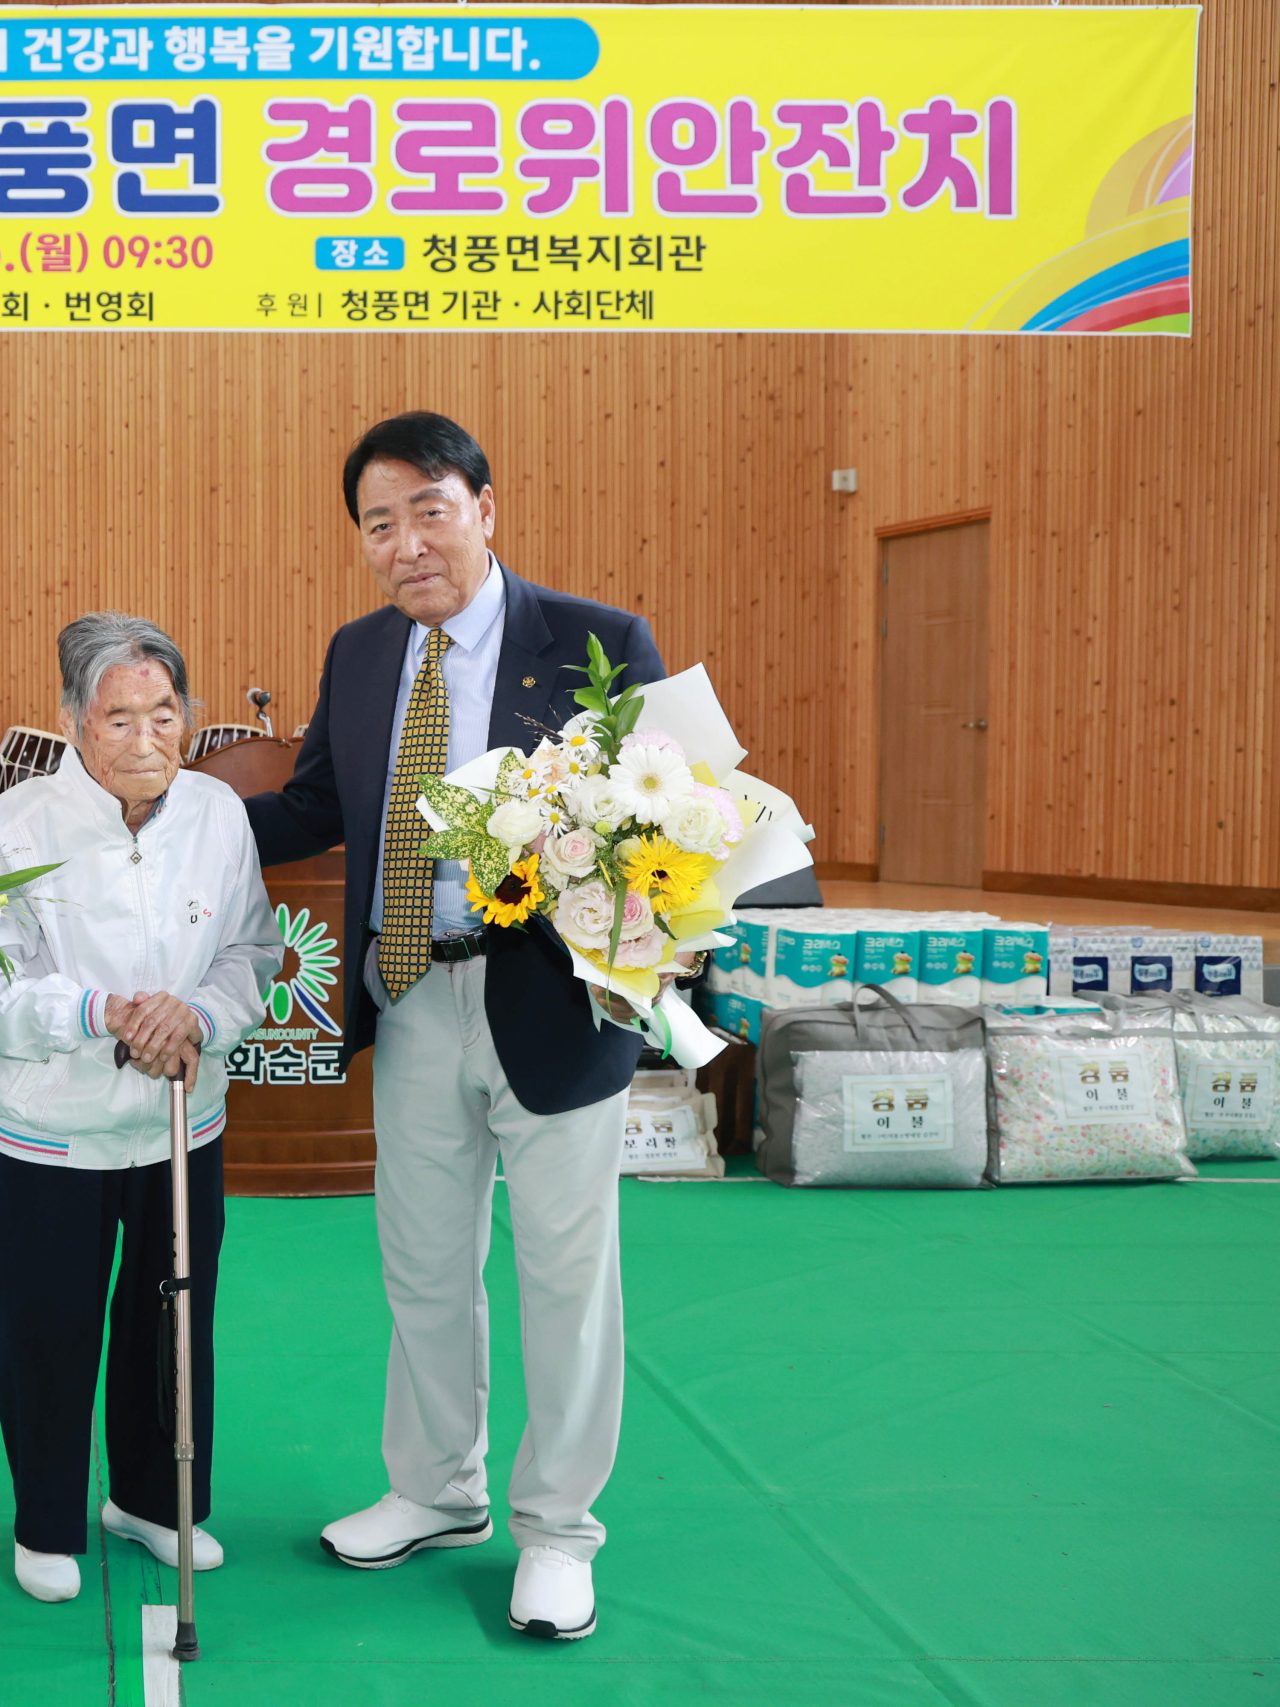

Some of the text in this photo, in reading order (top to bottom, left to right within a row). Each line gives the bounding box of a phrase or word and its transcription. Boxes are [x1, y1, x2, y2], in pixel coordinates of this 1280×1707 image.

[23, 27, 154, 73] 건강과
[164, 25, 296, 72] 행복을
[309, 25, 541, 71] 기원합니다.
[266, 99, 1013, 216] 경로위안잔치
[102, 235, 214, 270] 09:30
[331, 234, 706, 273] 장소 청풍면복지회관
[65, 291, 154, 322] 번영회
[257, 289, 655, 322] 후원 청풍면 기관 사회단체
[225, 1043, 346, 1084] 화순군
